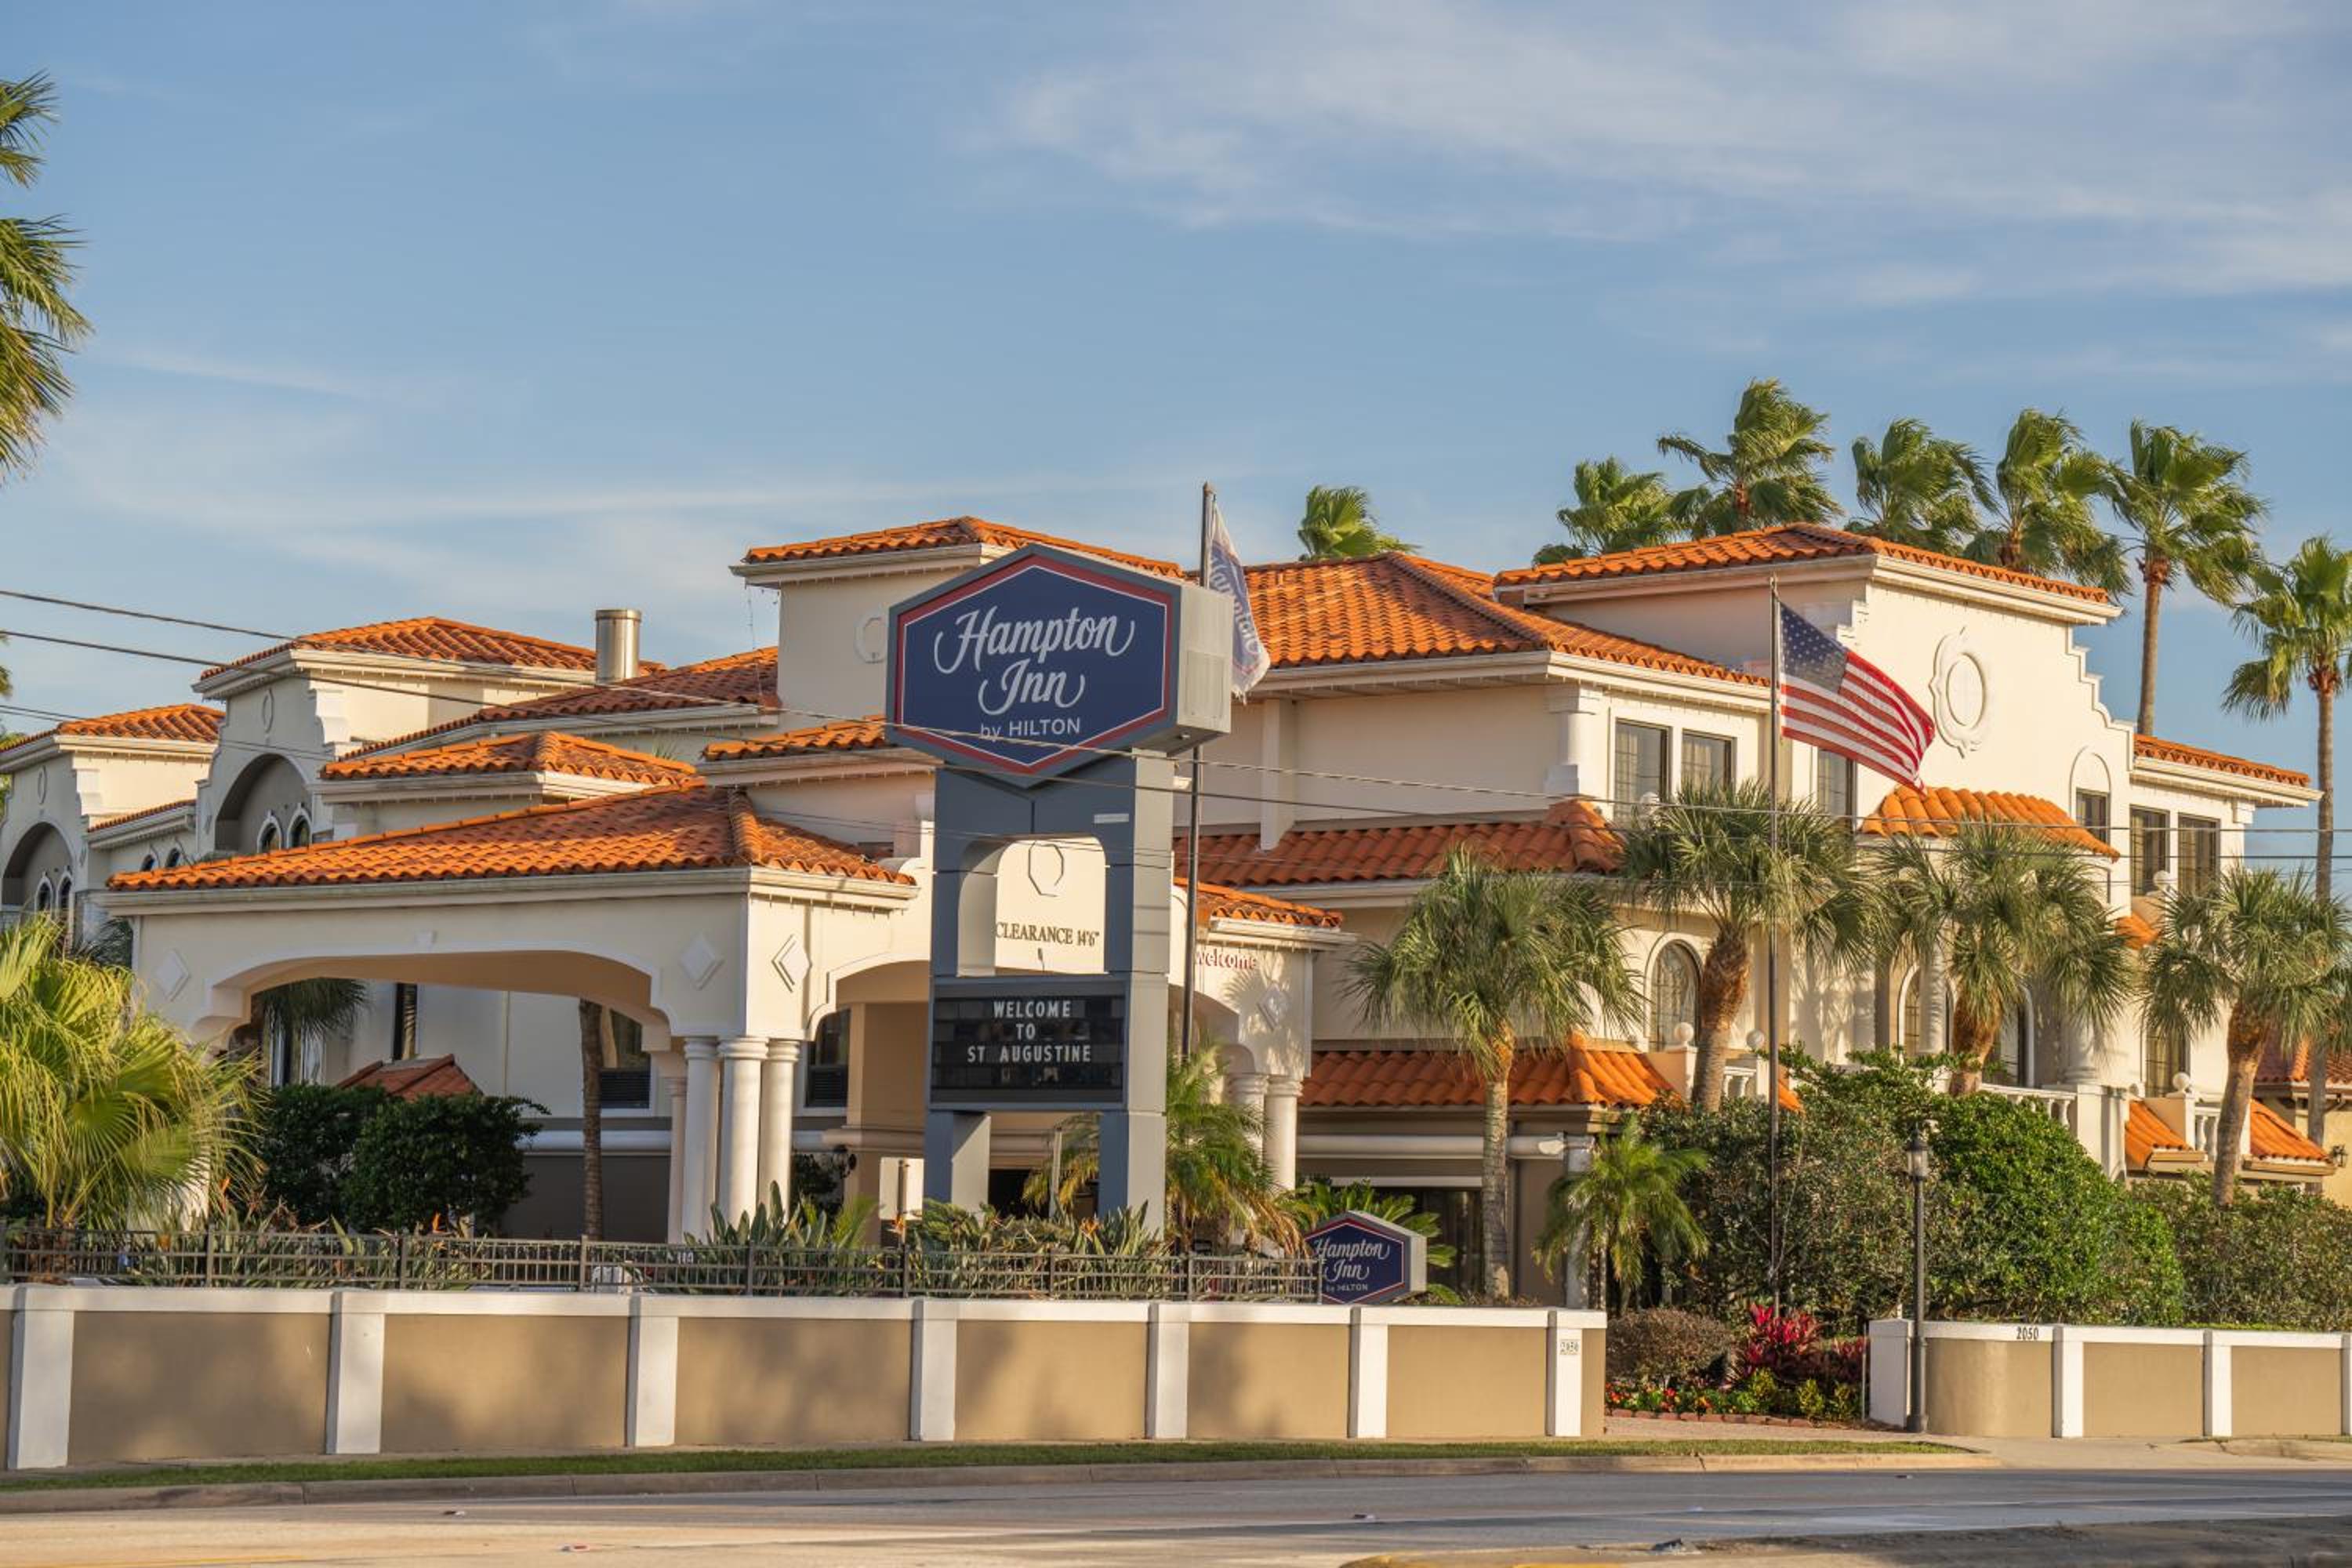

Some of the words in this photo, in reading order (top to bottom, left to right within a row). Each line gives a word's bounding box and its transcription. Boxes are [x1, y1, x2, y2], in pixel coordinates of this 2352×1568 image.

[934, 605, 1135, 673] Hampton
[978, 658, 1085, 715] Inn
[981, 723, 1002, 742] by
[1009, 717, 1080, 736] HILTON
[996, 922, 1073, 944] CLEARANCE
[993, 1000, 1072, 1018] WELCOME
[1016, 1023, 1036, 1040] TO
[967, 1046, 985, 1062] ST
[1000, 1045, 1091, 1062] AUGUSTINE
[1312, 1237, 1390, 1261] Hampton
[1324, 1259, 1370, 1282] Inn
[2016, 1326, 2040, 1340] 2050
